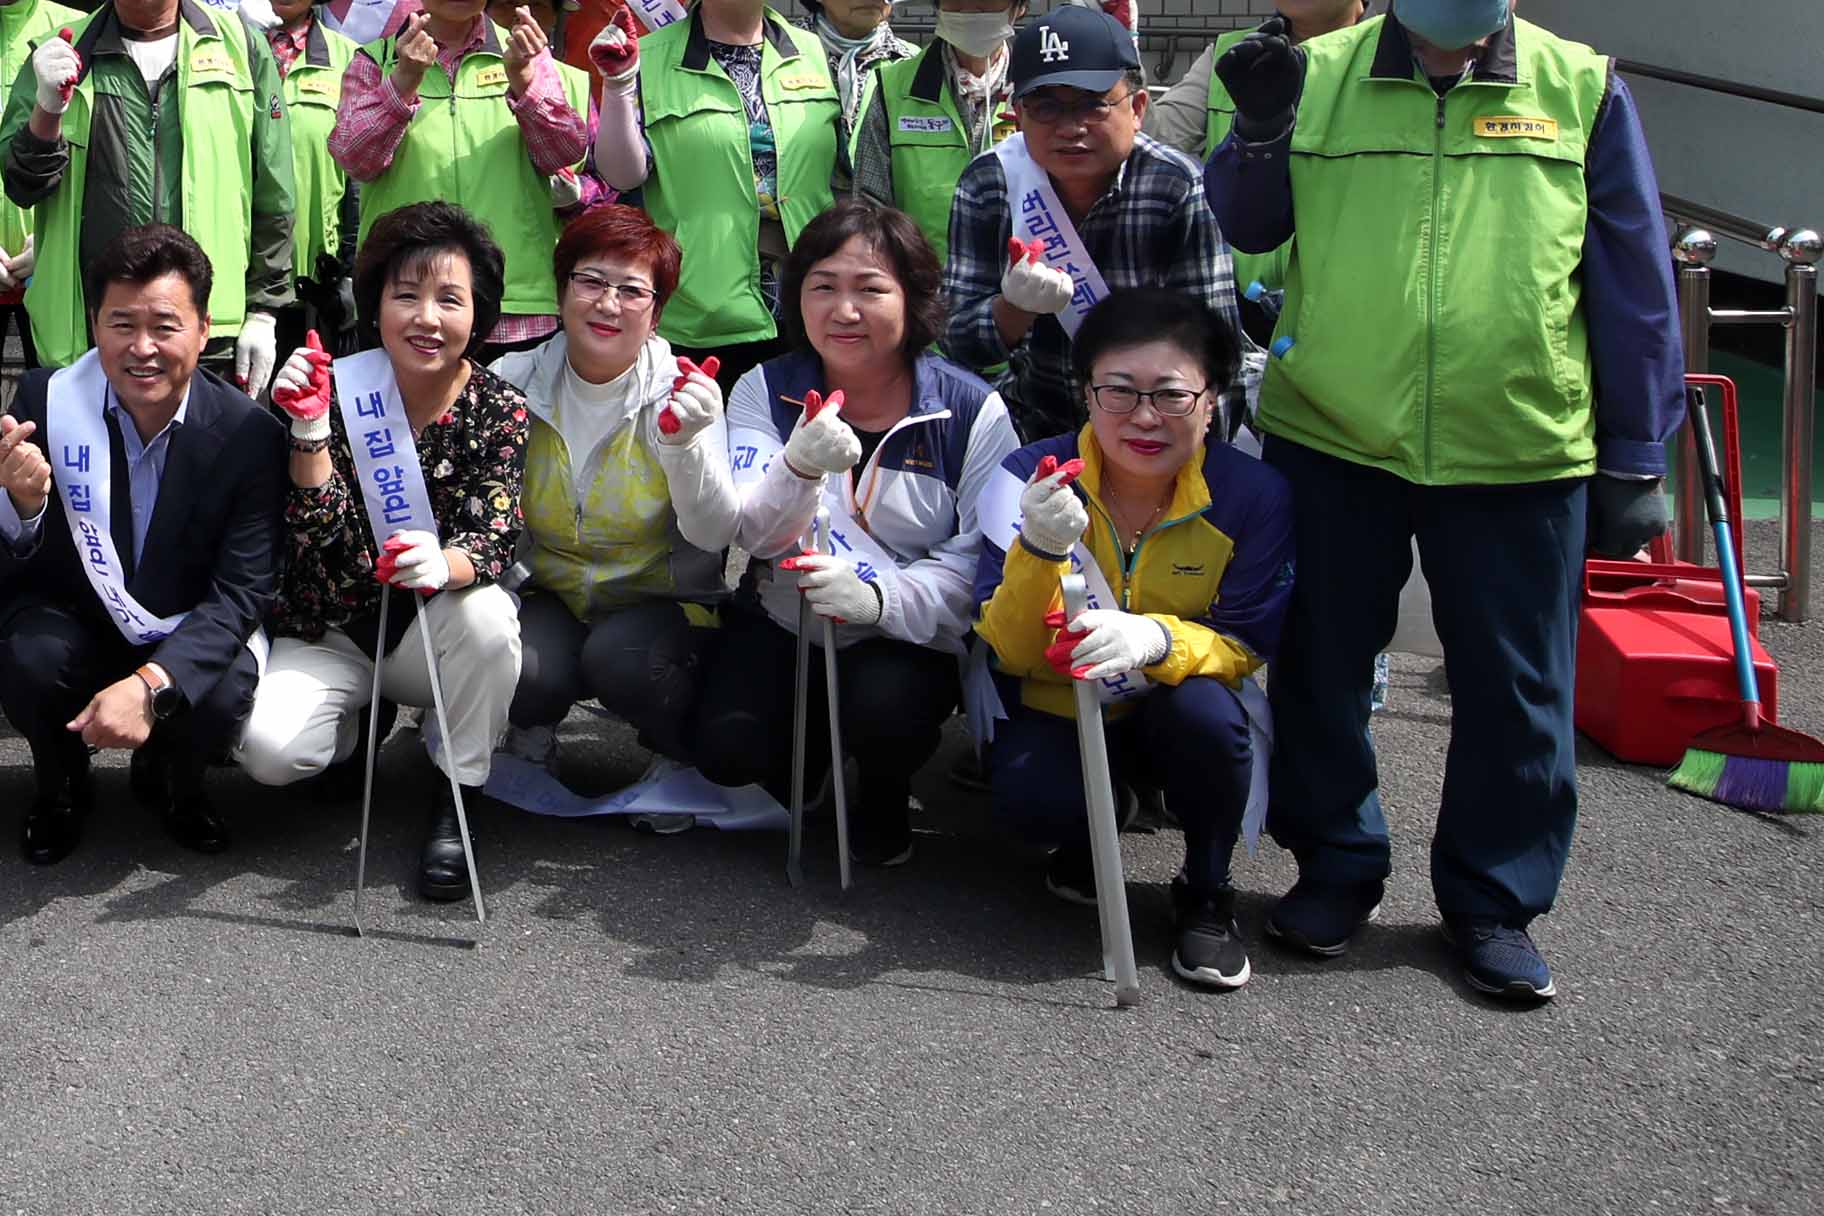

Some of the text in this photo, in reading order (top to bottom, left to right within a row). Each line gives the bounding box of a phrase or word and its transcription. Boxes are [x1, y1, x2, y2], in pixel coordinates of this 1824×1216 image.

[1039, 25, 1069, 63] LA
[63, 444, 91, 474] 내
[355, 390, 413, 525] 내 집 앞은
[68, 483, 92, 514] 집
[78, 519, 110, 578] 앞은
